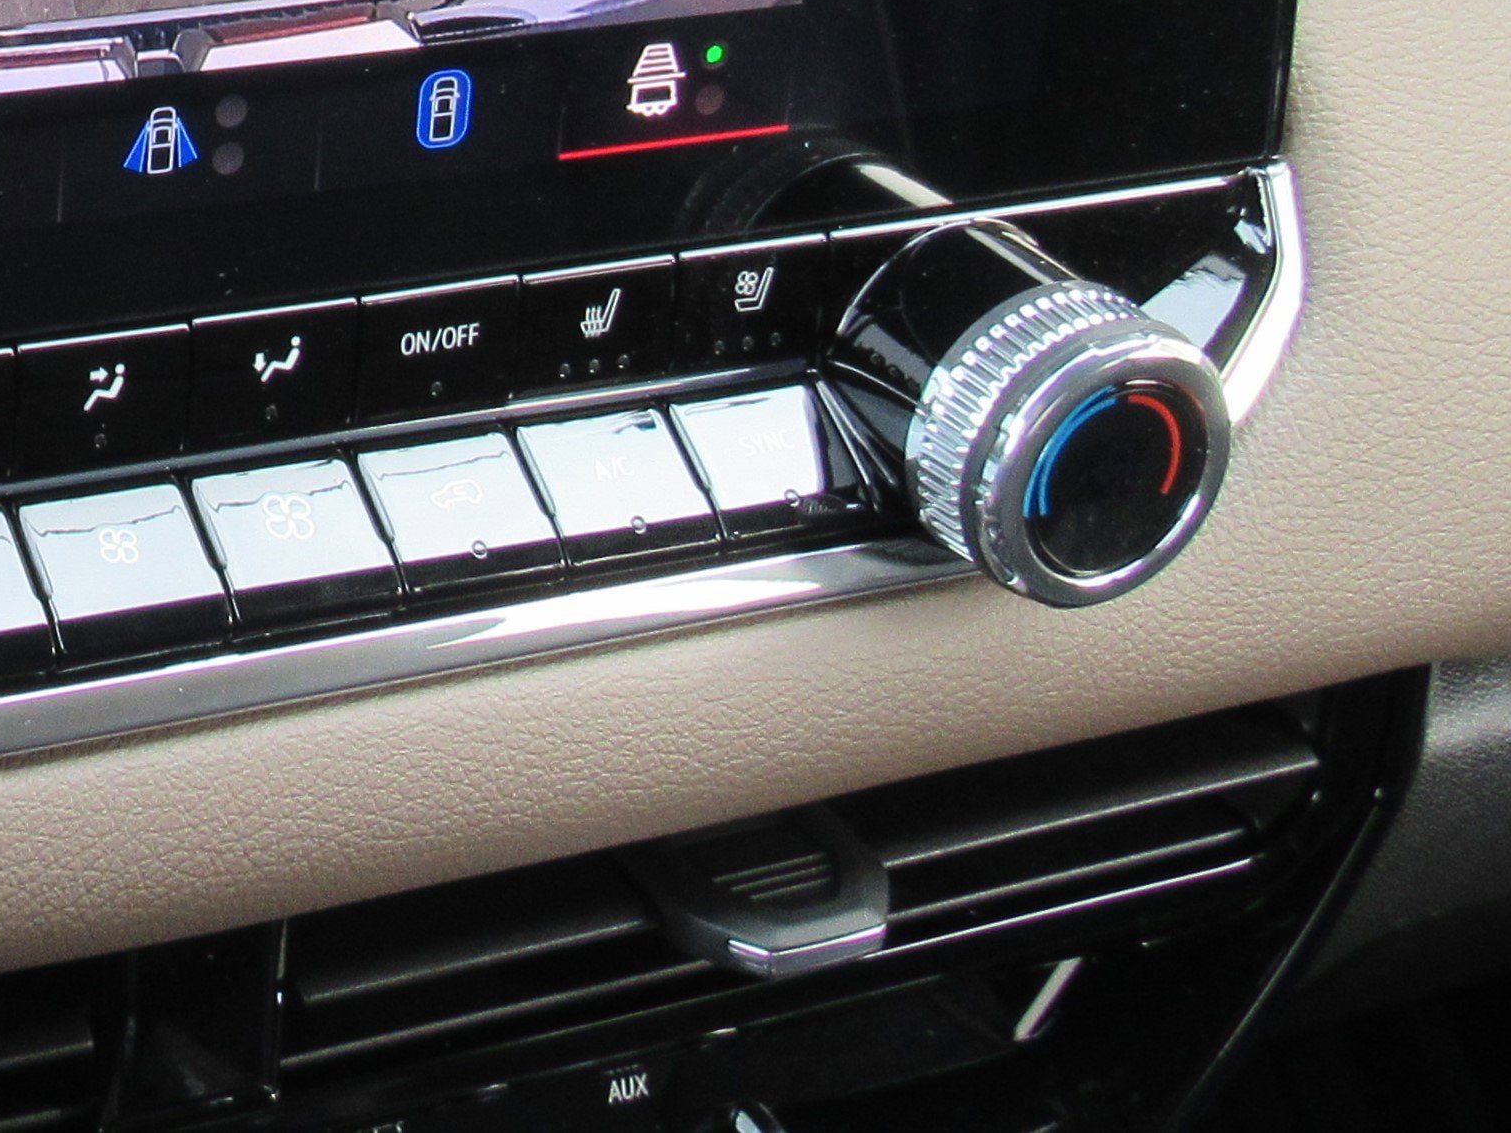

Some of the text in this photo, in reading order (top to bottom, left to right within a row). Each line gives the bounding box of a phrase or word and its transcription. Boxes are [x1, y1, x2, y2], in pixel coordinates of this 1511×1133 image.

[400, 322, 480, 356] ON/OFF
[737, 427, 795, 458] SYNC
[594, 456, 635, 481] A/C
[607, 1072, 649, 1104] AUX
